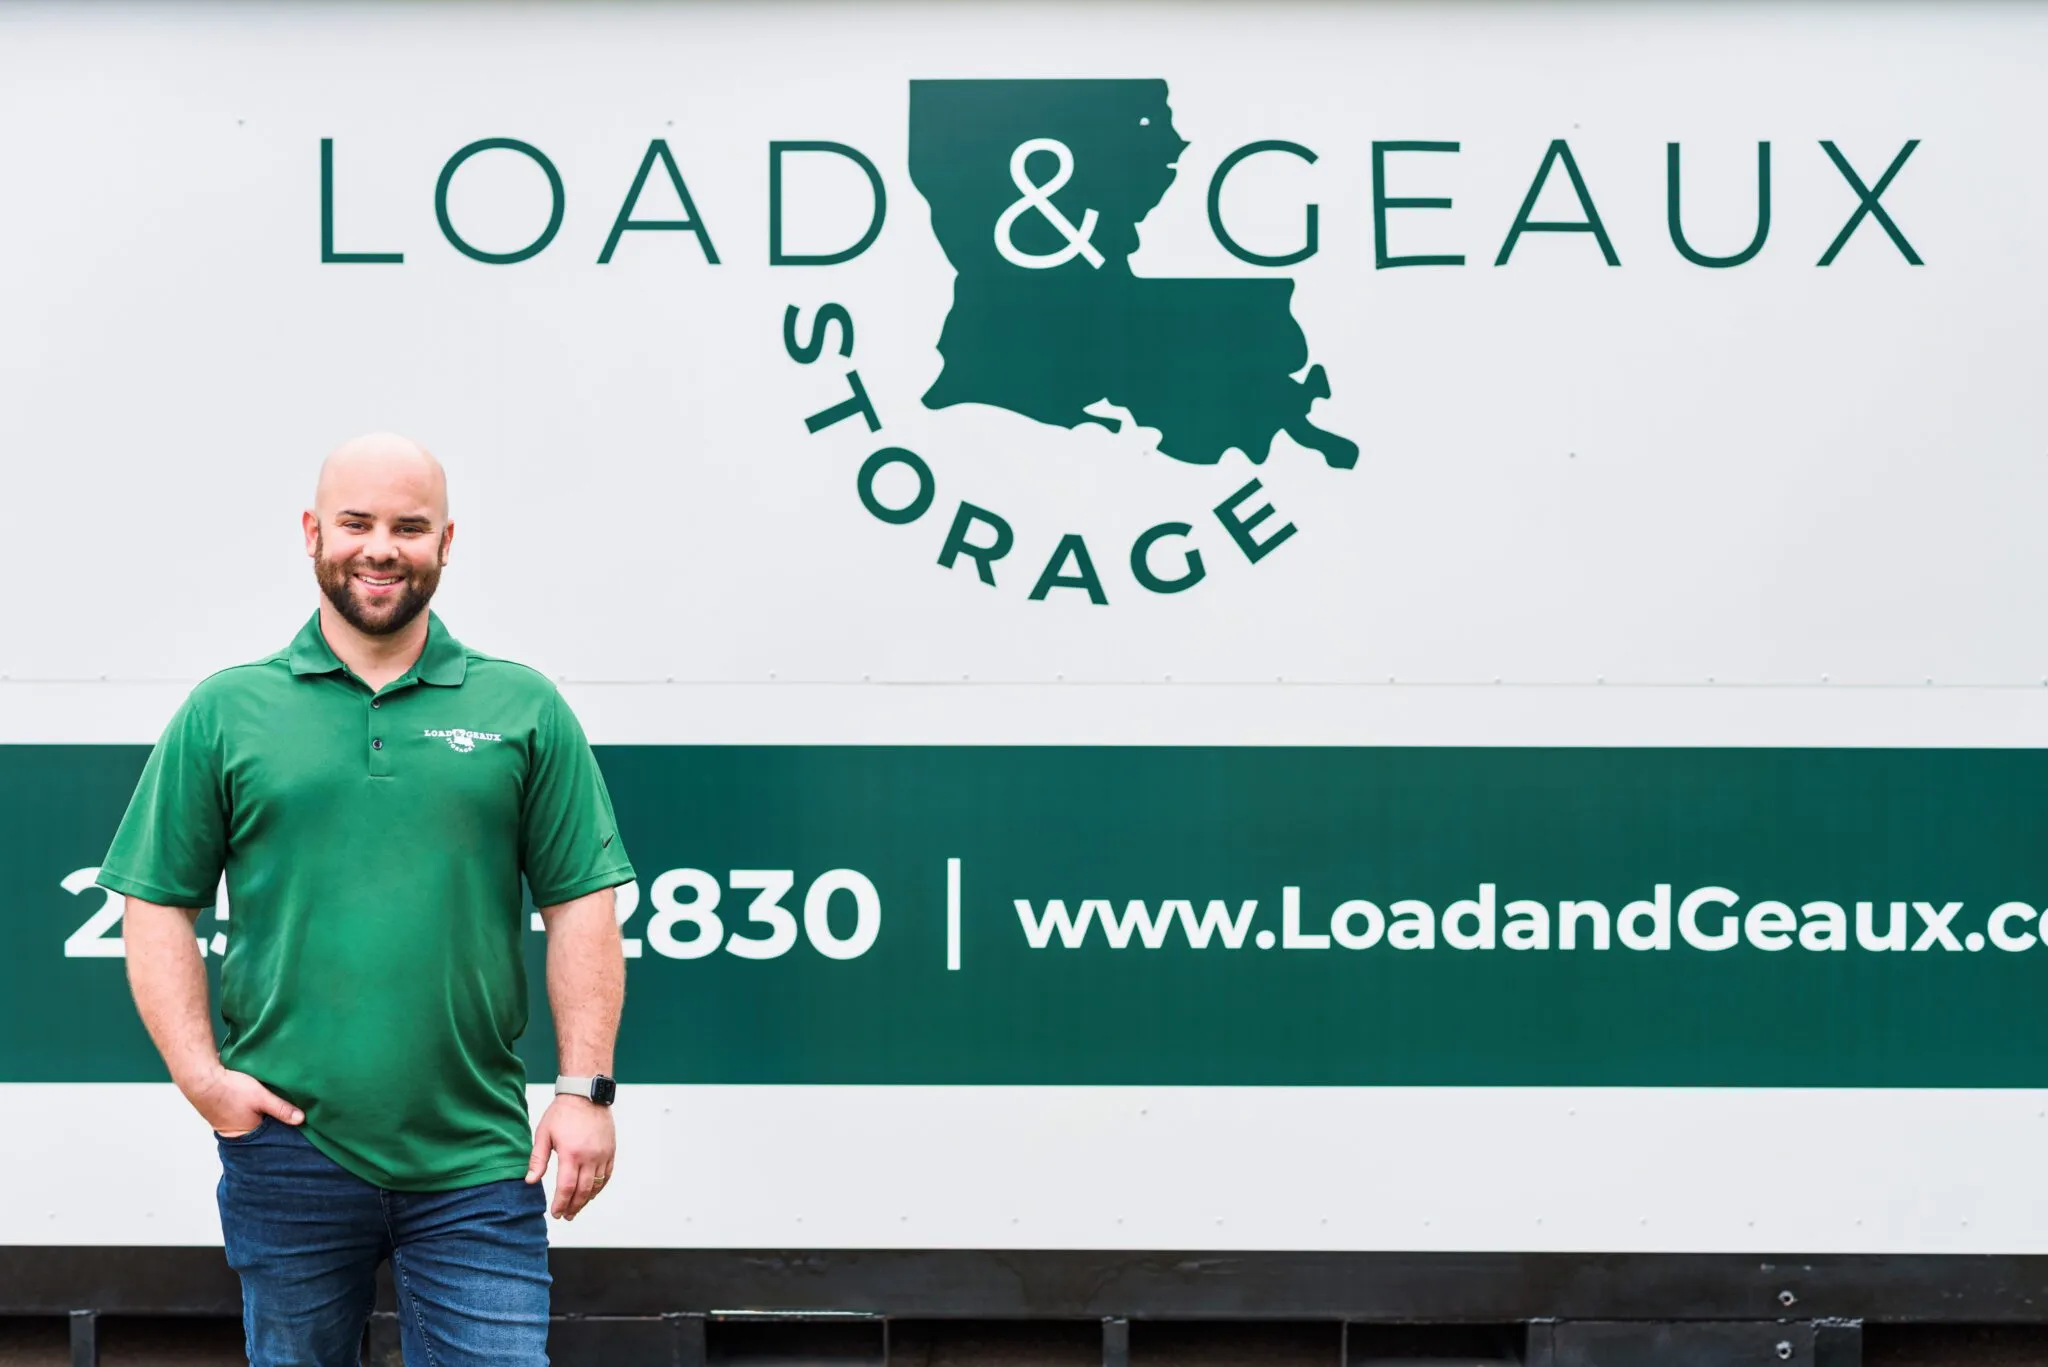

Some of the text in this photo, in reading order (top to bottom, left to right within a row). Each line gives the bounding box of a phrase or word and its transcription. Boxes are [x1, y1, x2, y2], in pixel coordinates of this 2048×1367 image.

[321, 138, 1924, 270] LOAD & GEAUX
[784, 302, 1298, 605] STORAGE
[424, 729, 453, 738] LOAD
[1014, 883, 2048, 952] www.LoadandGeaux.c
